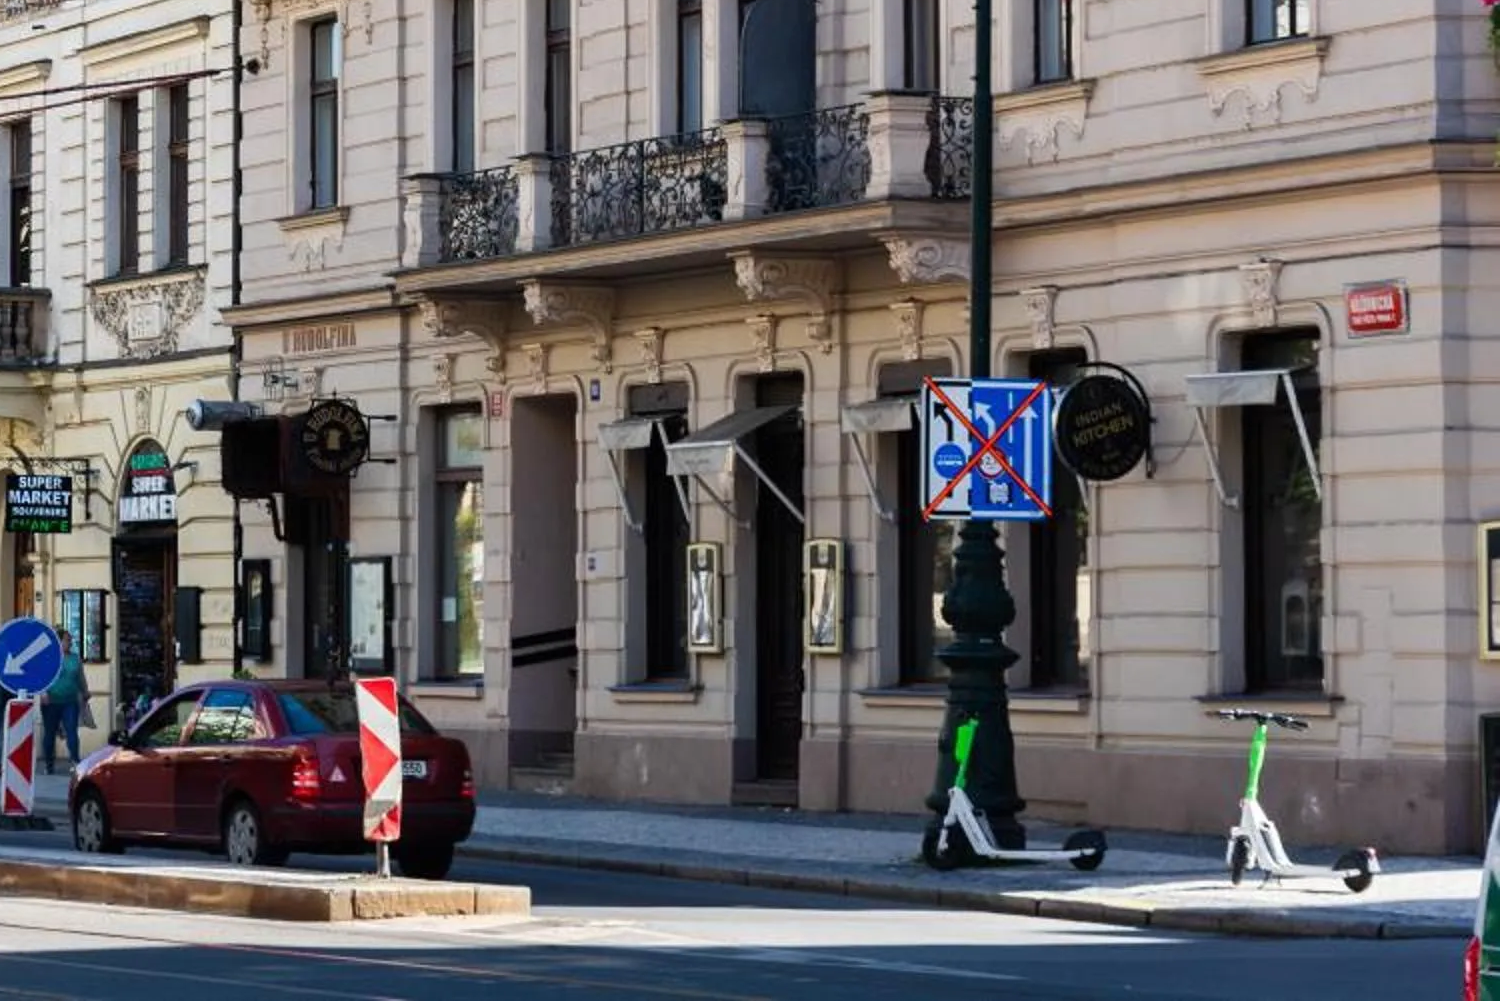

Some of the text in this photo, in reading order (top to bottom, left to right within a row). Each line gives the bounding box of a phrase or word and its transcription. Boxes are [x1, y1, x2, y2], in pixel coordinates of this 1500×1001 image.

[1075, 402, 1123, 426] INDIAN
[1073, 415, 1134, 448] KITCHEN
[18, 476, 62, 490] SUPER
[8, 490, 70, 505] MARKET
